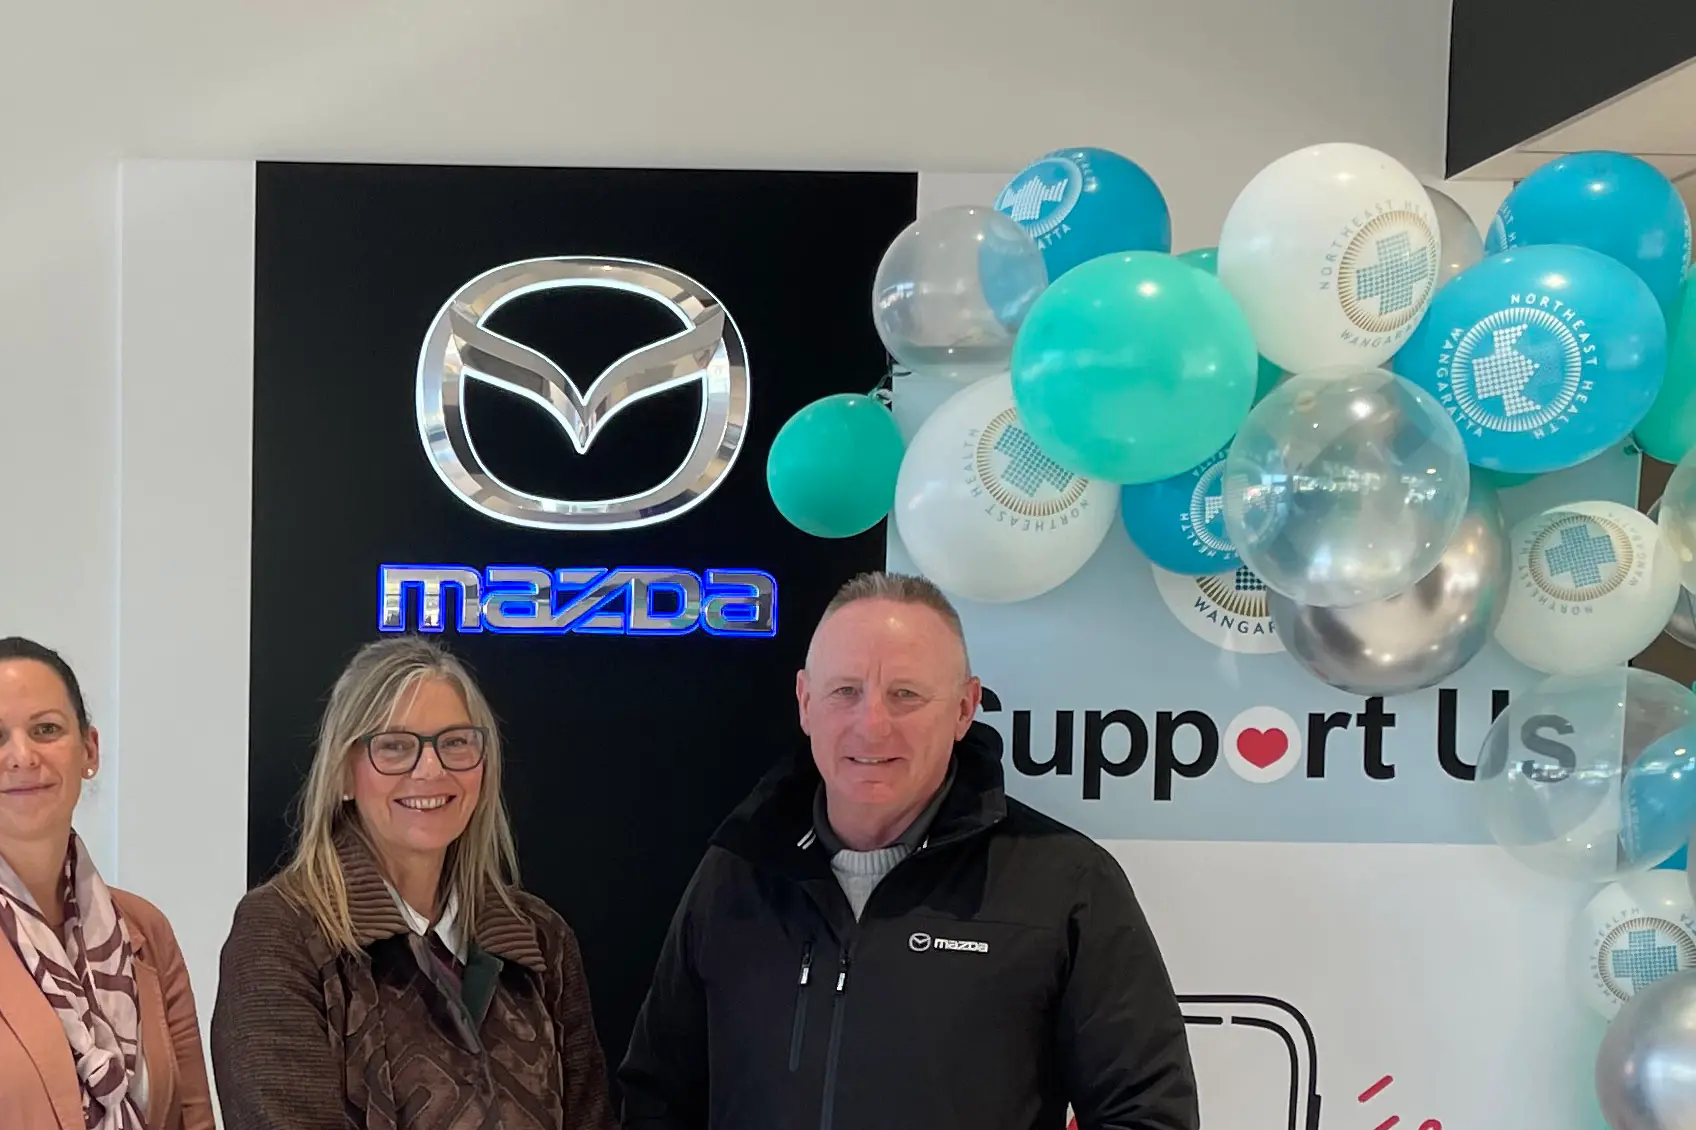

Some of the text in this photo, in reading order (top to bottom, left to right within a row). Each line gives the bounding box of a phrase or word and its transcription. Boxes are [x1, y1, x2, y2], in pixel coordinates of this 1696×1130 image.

[1436, 326, 1483, 438] WANGARATTA
[1511, 293, 1598, 440] NORTHEAST HEALTH
[961, 428, 1089, 532] NORTHEAST HEALTH
[377, 563, 777, 637] mazda
[1194, 596, 1277, 635] WANGAR
[981, 686, 1577, 801] upport Us
[934, 938, 989, 953] mazda
